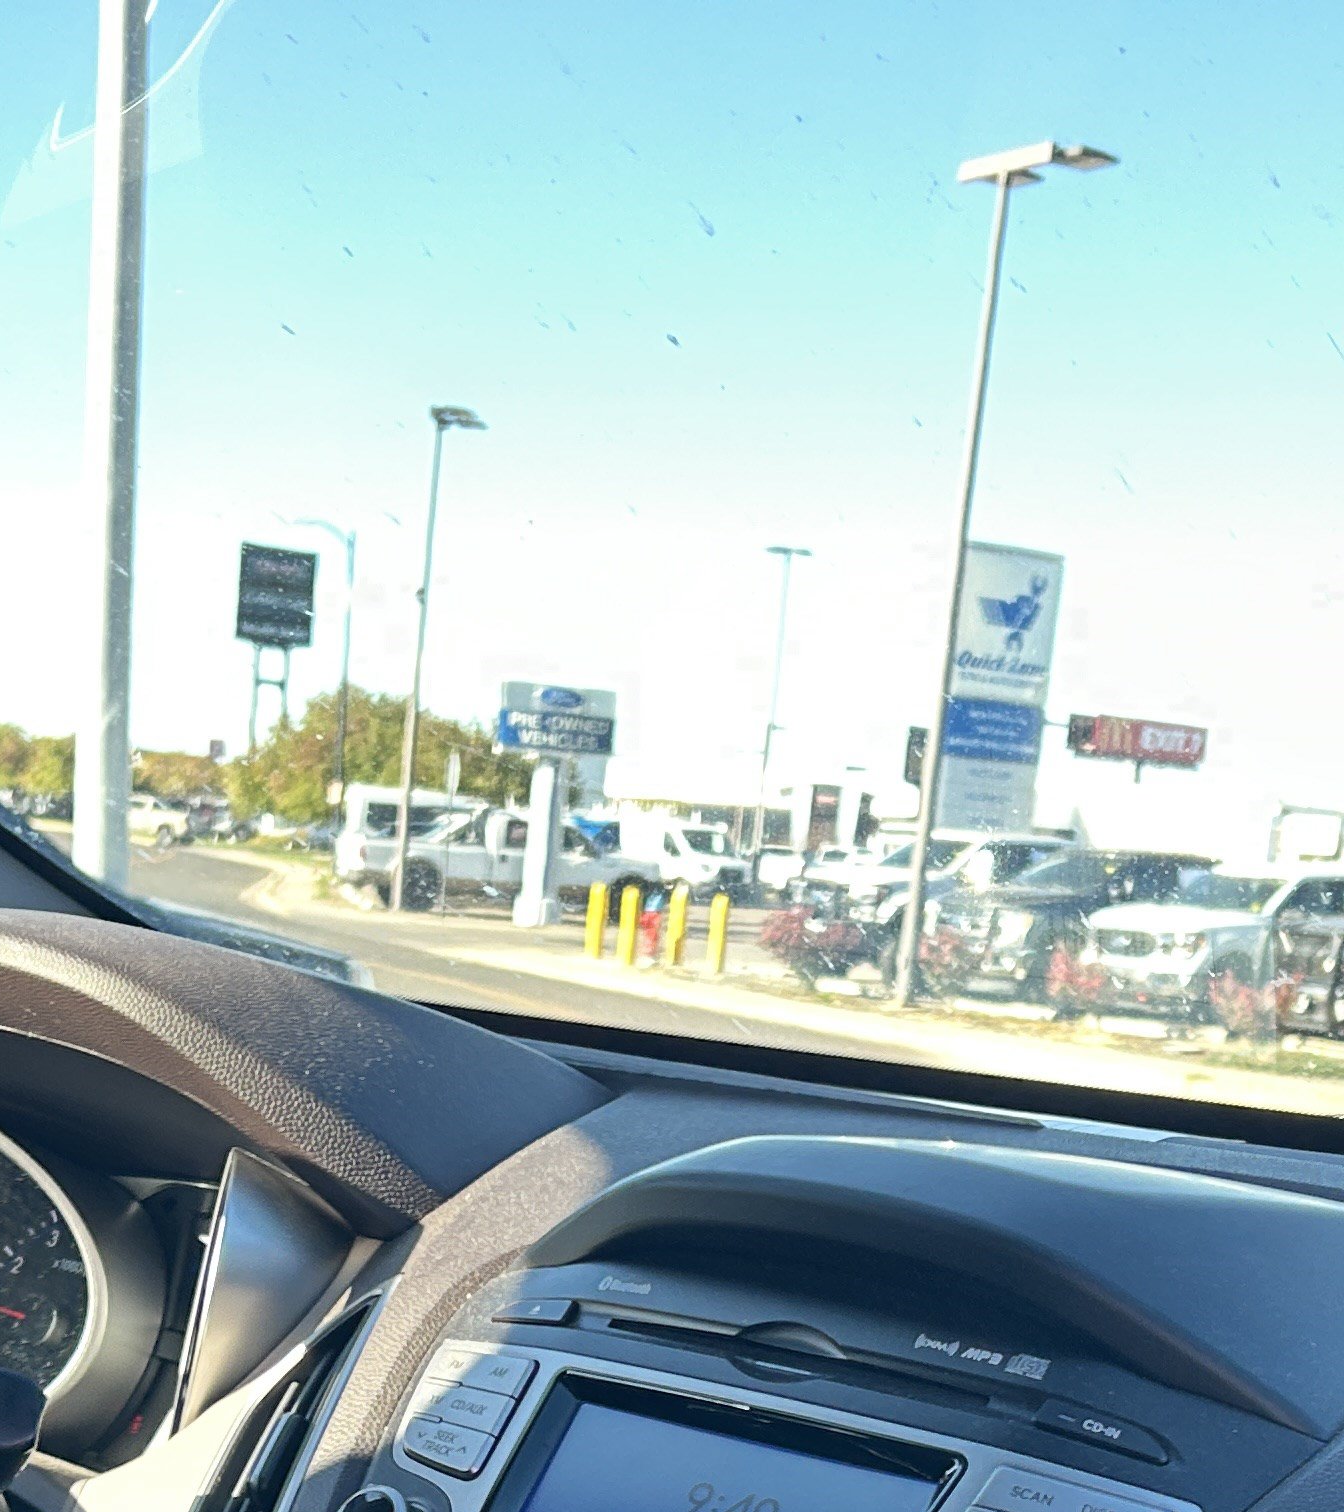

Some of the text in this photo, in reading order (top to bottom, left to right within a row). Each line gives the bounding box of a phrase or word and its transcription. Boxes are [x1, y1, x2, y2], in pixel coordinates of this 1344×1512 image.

[10, 1256, 24, 1275] 2
[961, 1347, 1003, 1367] MP3
[450, 1399, 488, 1416] CD/AUX
[1082, 1418, 1122, 1440] CD-IN
[422, 1439, 453, 1457] TRACK
[1009, 1485, 1055, 1506] SCAN
